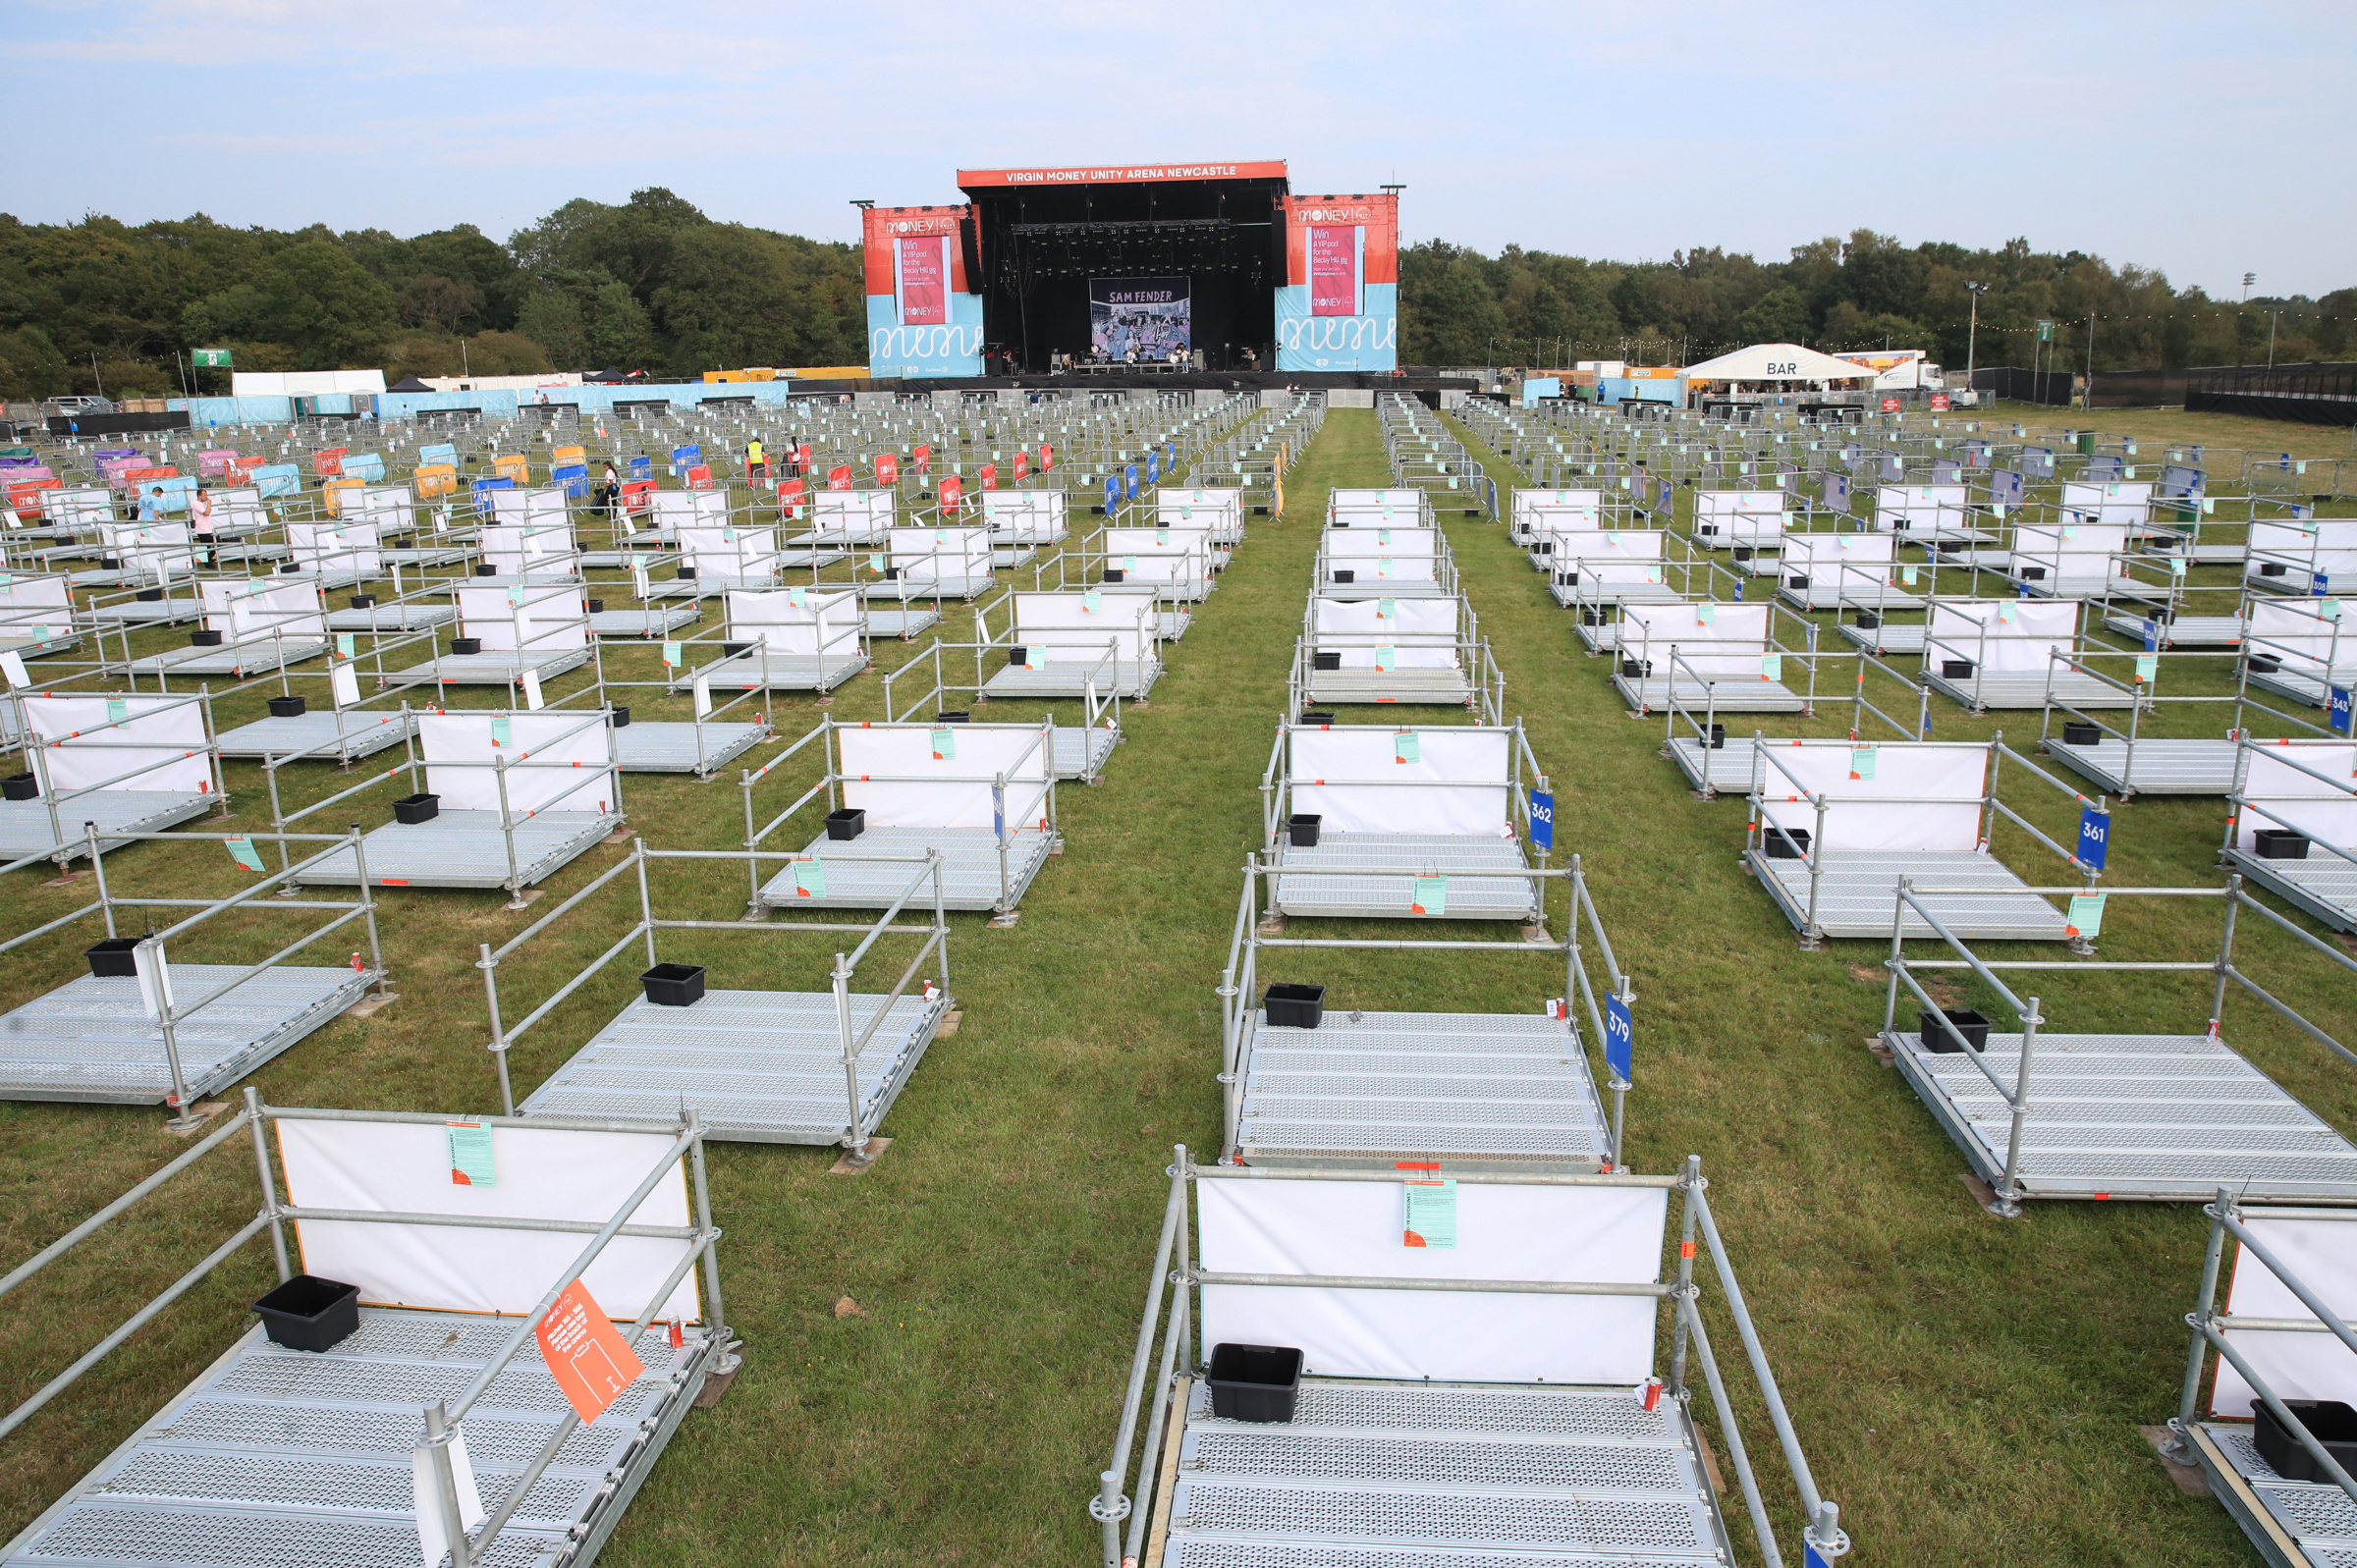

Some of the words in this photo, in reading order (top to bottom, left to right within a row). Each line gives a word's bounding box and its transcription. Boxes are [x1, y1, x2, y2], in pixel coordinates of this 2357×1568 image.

[1006, 172, 1044, 183] VIRGIN
[1046, 170, 1087, 181] MONEY
[1090, 169, 1124, 180] UNITY
[1126, 168, 1164, 179] ARENA
[1167, 166, 1236, 178] NEWCASTLE
[1298, 209, 1349, 222] MONEY
[886, 220, 934, 234] MONEY
[1313, 229, 1330, 239] Win
[902, 240, 917, 250] Win
[1109, 292, 1132, 302] SAM
[1134, 291, 1173, 302] FENDER
[1313, 297, 1342, 306] MONEY
[904, 306, 932, 316] MONEY
[1767, 362, 1797, 374] BAR
[2314, 580, 2327, 591] 308
[2332, 697, 2348, 712] 343
[1532, 802, 1552, 823] 362
[2083, 822, 2105, 842] 361
[1609, 1009, 1629, 1043] 379
[546, 1323, 564, 1342] Pitches
[551, 1328, 568, 1347] Please
[566, 1319, 576, 1330] use
[575, 1310, 586, 1322] bar
[555, 1343, 562, 1352] at
[560, 1336, 570, 1346] the
[567, 1323, 583, 1338] back
[581, 1316, 588, 1325] of
[562, 1342, 572, 1353] the
[571, 1327, 587, 1345] arena
